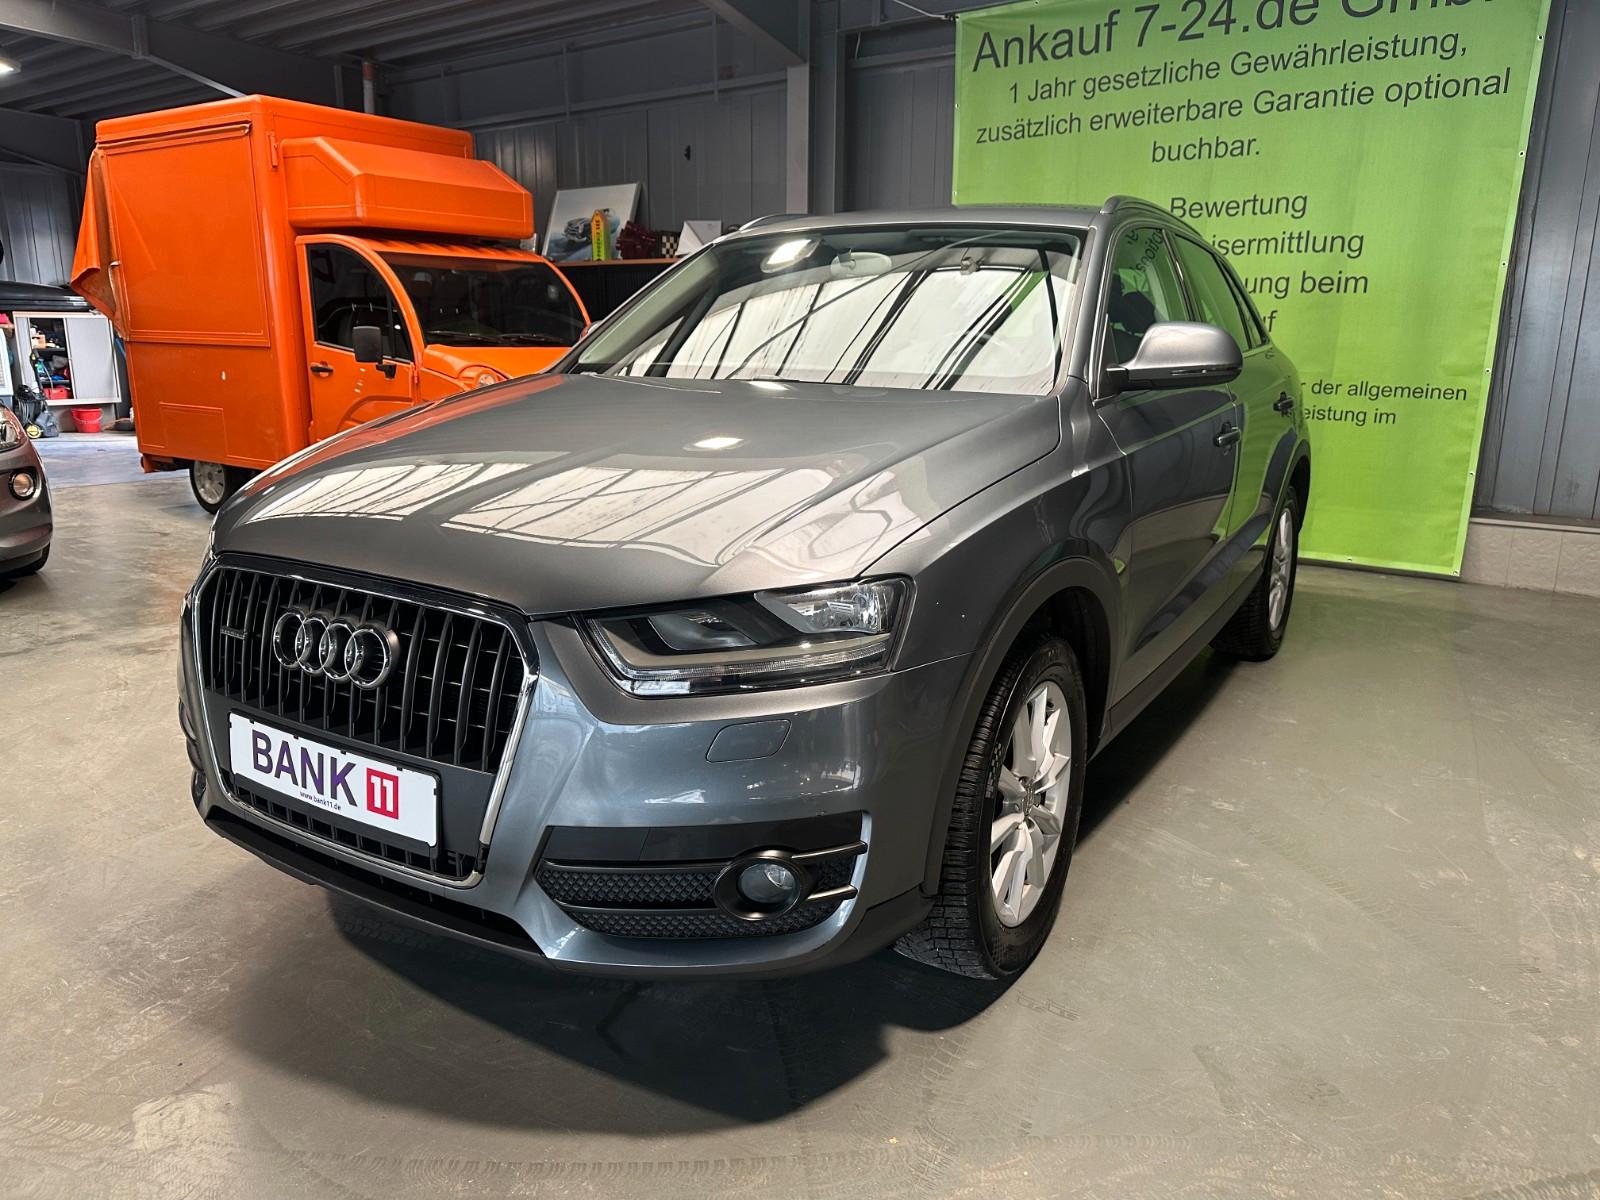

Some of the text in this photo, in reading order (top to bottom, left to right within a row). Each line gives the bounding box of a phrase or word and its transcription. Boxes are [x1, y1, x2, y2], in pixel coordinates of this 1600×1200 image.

[972, 0, 1319, 72] Ankauf 7-24.de
[1009, 33, 1467, 103] 1 Jahr gesetzliche Gewährleistung,
[976, 67, 1511, 144] zusätzlich erweiterbare Garantie optional
[1151, 136, 1260, 163] buchbar.
[1170, 194, 1308, 219] Bewertung
[1211, 230, 1364, 259] isermittlung
[1245, 270, 1369, 299] ung beim
[1311, 379, 1467, 401] der allgemeinen
[1304, 404, 1397, 427] eistung im
[251, 729, 395, 814] BANK 11
